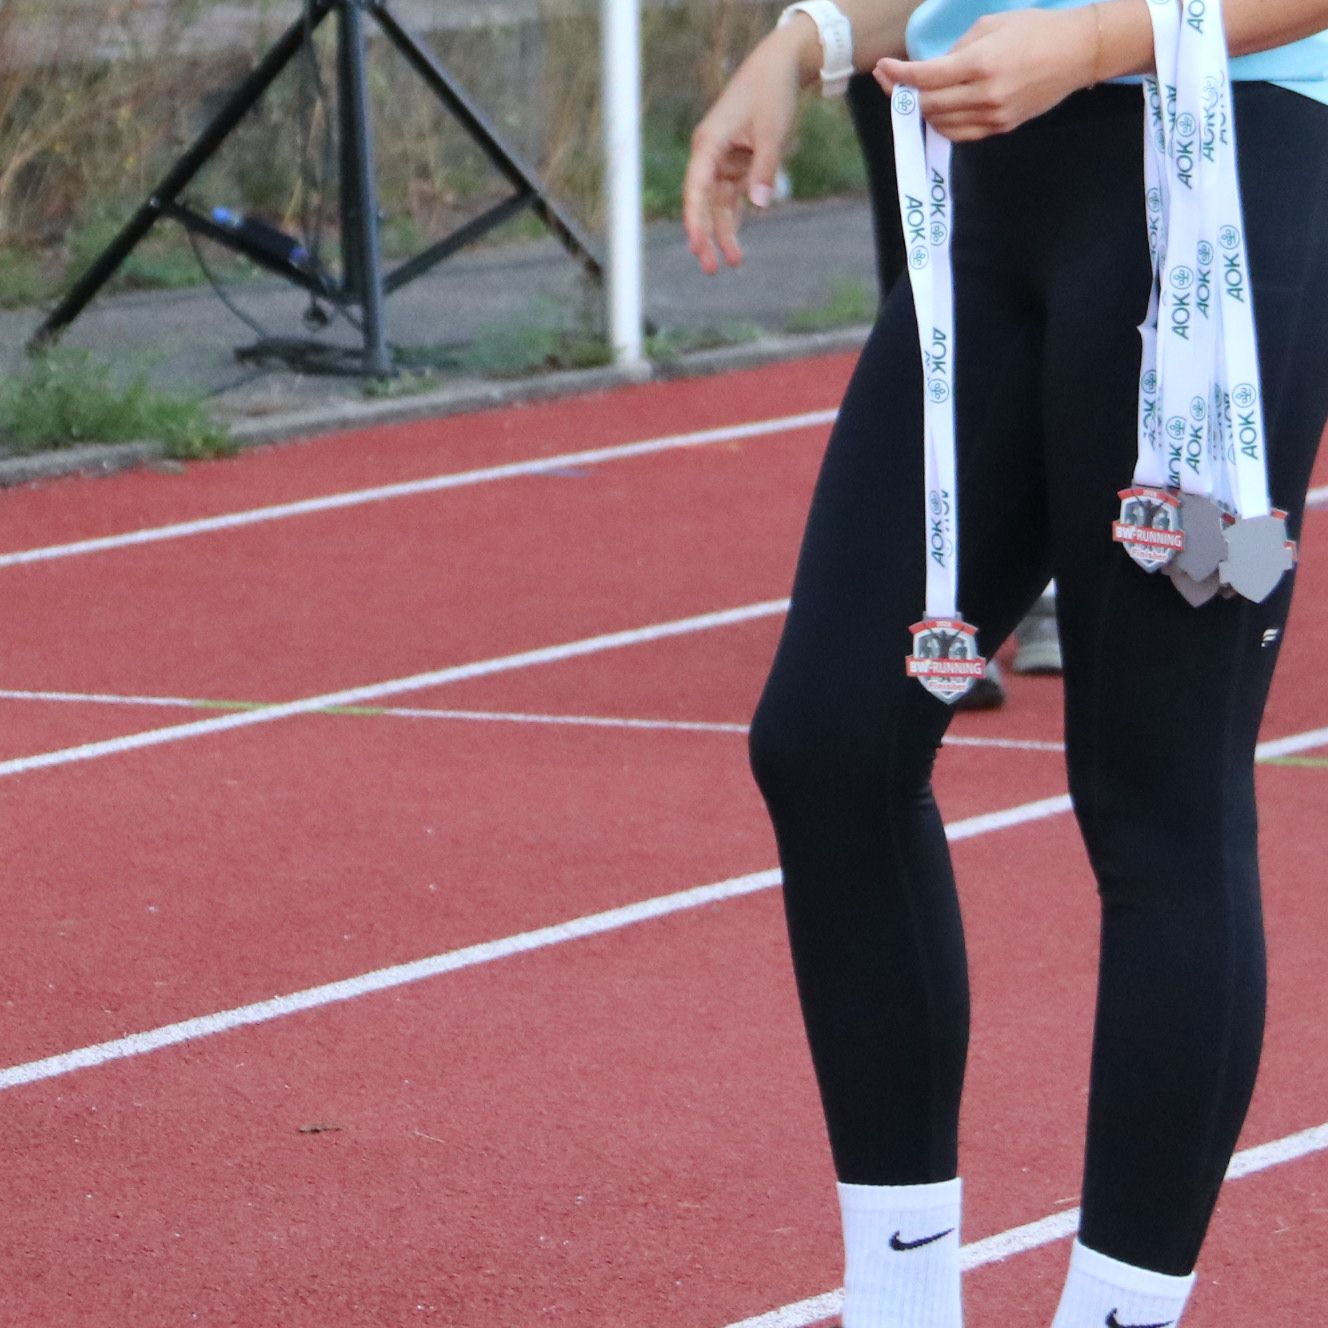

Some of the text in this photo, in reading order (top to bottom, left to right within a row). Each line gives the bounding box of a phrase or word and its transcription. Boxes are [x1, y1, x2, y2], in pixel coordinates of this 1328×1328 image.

[1175, 140, 1193, 190] AOK
[930, 167, 946, 219] AOK
[905, 194, 927, 244] AOK
[1196, 268, 1211, 320] AOK
[1224, 253, 1245, 304] AOK
[1171, 292, 1191, 341] AOK
[932, 327, 947, 375] AOK
[1186, 423, 1204, 476] AOK
[1235, 410, 1259, 461] AOK
[931, 517, 946, 568] AOK
